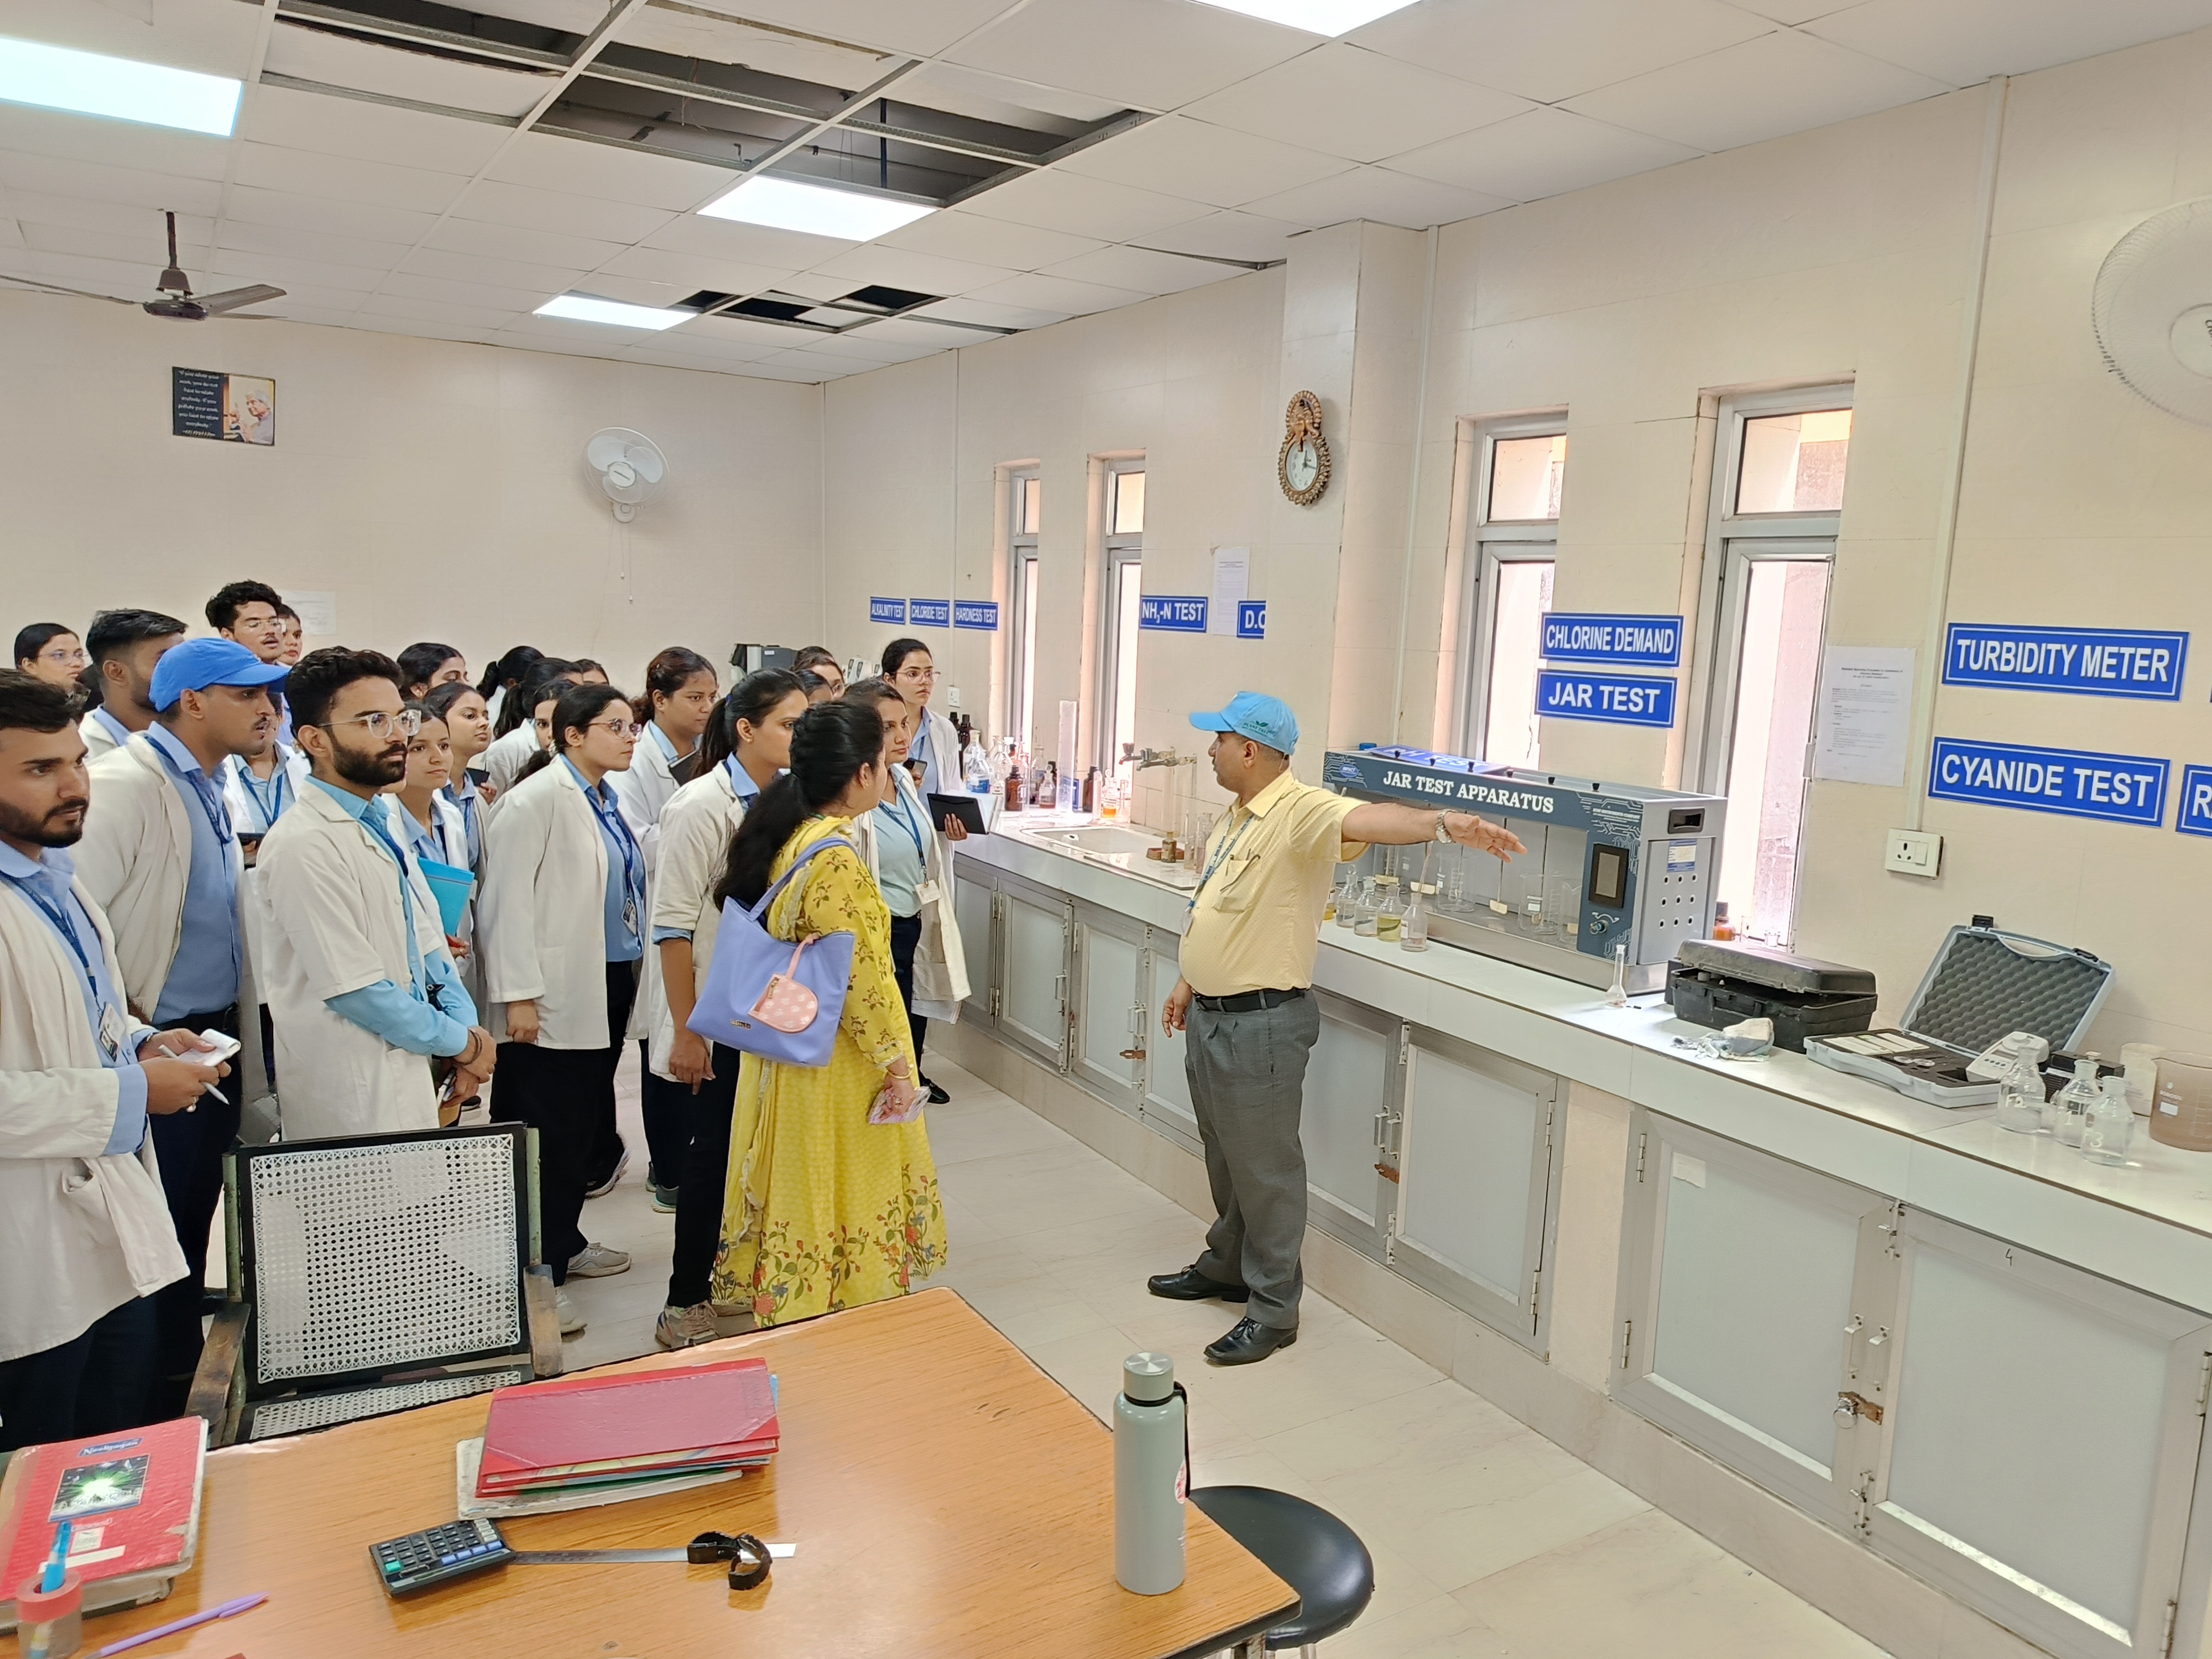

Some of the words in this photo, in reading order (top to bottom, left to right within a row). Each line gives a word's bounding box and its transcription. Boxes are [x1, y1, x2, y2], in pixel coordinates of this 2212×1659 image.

[894, 605, 904, 618] TEST
[911, 604, 935, 619] CHLORIDE
[935, 606, 948, 620] TEST
[956, 607, 983, 622] HARDNESS
[983, 609, 997, 623] TEST
[1175, 603, 1204, 621] TEST
[1546, 625, 1612, 651] CHLORINE
[1614, 627, 1674, 654] DEMAND
[1957, 639, 2078, 676] TURBIDITY
[2080, 645, 2171, 682] METER
[1548, 682, 1593, 708] JAR
[1599, 685, 1661, 713] TEST
[1425, 755, 1489, 767] TEST
[1383, 771, 1412, 789] JAR
[1415, 775, 1454, 796] TEST
[1457, 783, 1554, 813] APPARATUS
[1942, 754, 2065, 797] CYANIDE
[2073, 768, 2154, 807] TEST
[2192, 784, 2212, 818] R
[2005, 1093, 2027, 1109] F2
